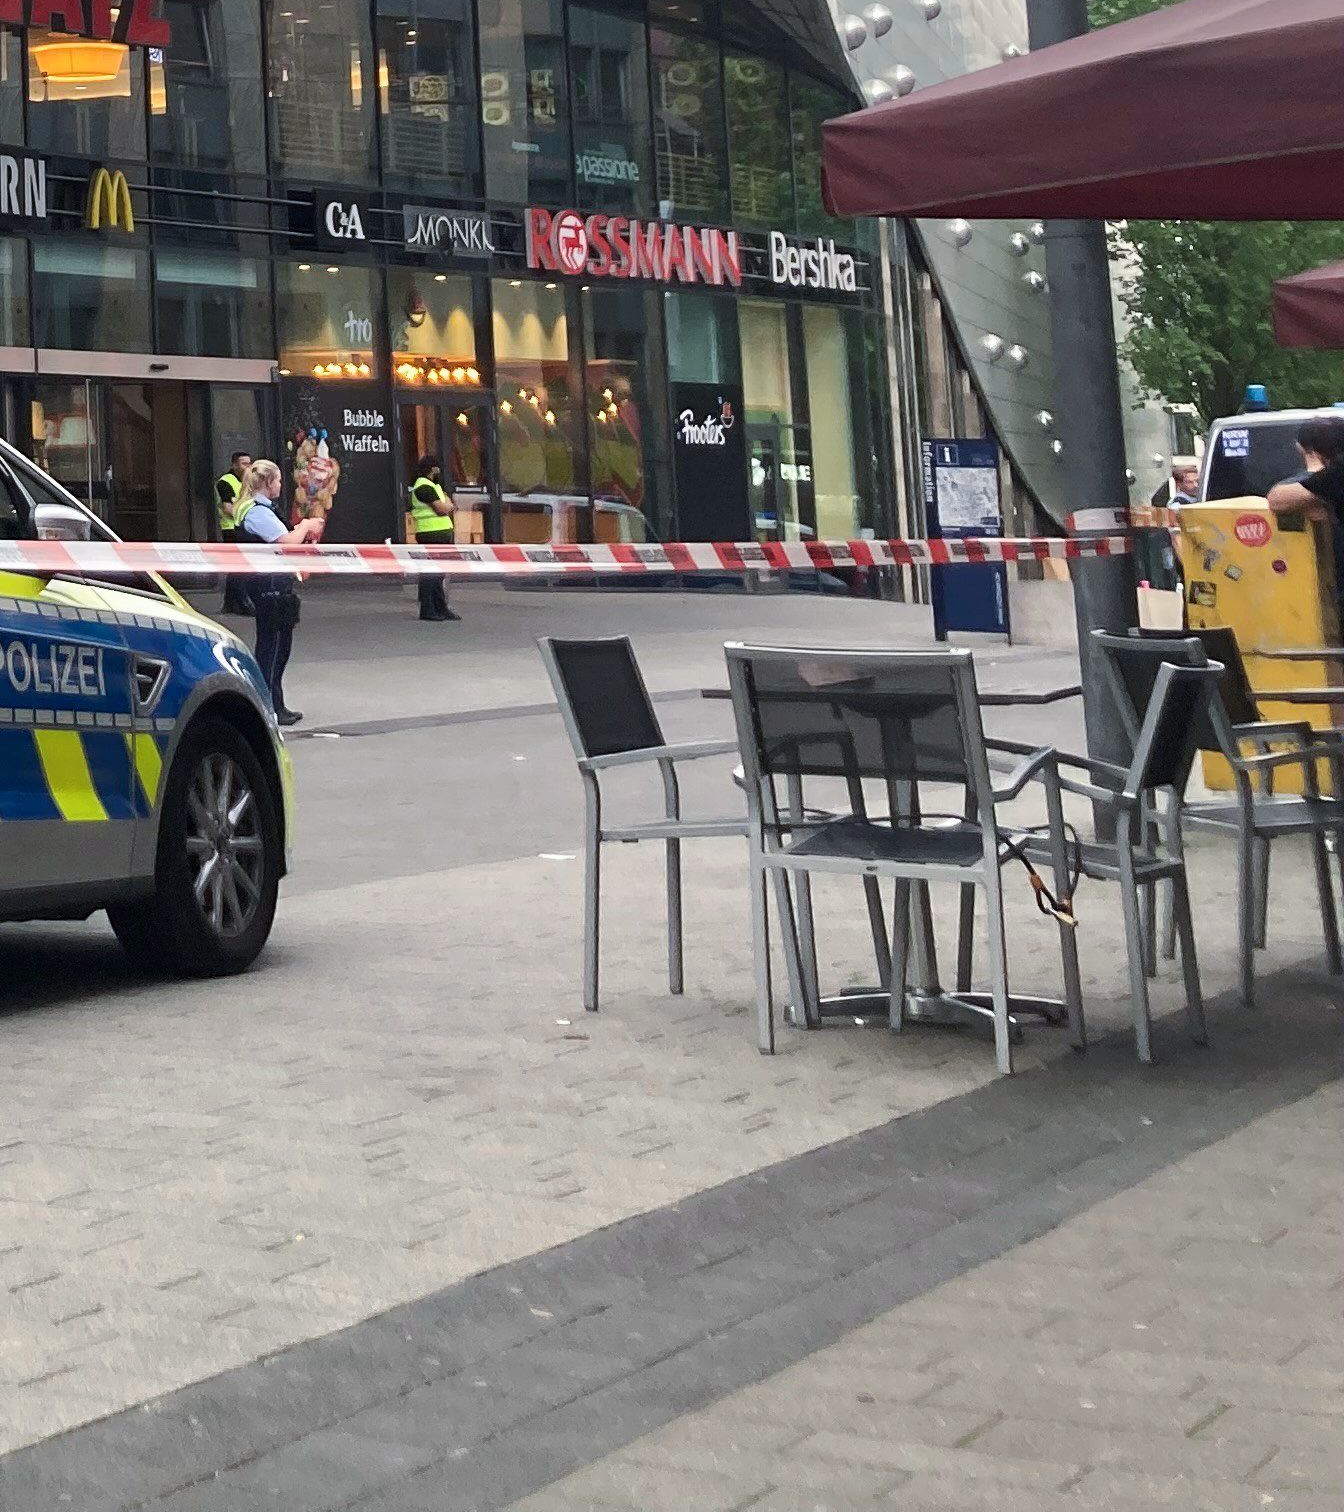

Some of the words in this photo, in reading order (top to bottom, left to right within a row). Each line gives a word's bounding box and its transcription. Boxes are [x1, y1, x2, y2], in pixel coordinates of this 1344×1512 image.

[583, 153, 640, 182] passione
[325, 201, 365, 239] C&A
[524, 207, 743, 287] ROSSMANN
[768, 230, 857, 292] Bershka
[343, 408, 385, 428] Bubble
[341, 434, 390, 453] Waffeln
